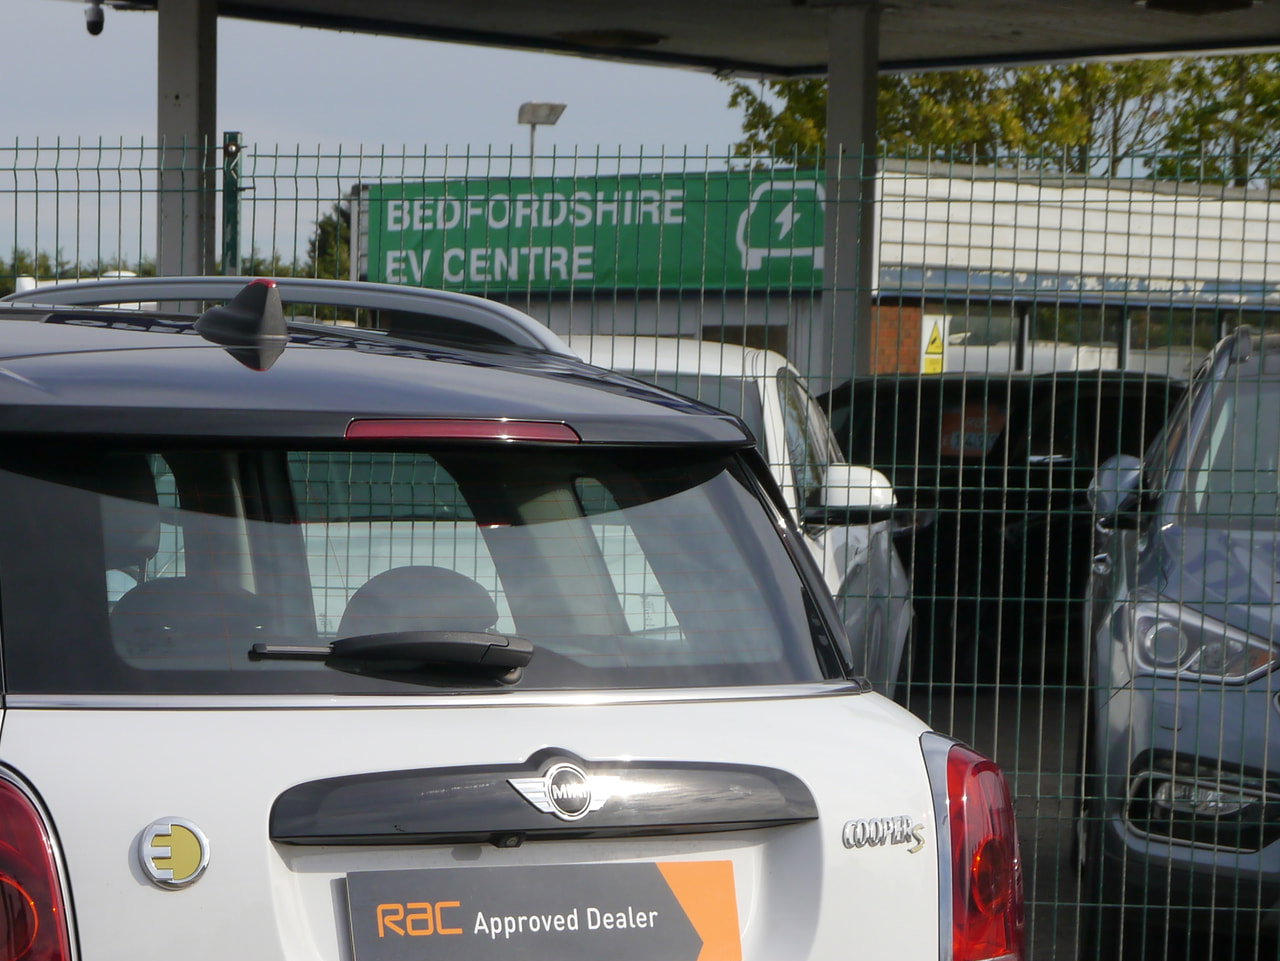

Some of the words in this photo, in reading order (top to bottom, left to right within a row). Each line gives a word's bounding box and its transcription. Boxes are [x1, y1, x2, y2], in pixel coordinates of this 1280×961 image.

[386, 188, 687, 232] BEDFORDSHIRE
[385, 248, 432, 283] EV
[443, 245, 595, 283] CENTRE
[842, 815, 912, 850] COOPER
[473, 908, 579, 940] Approved
[586, 906, 659, 931] Dealer
